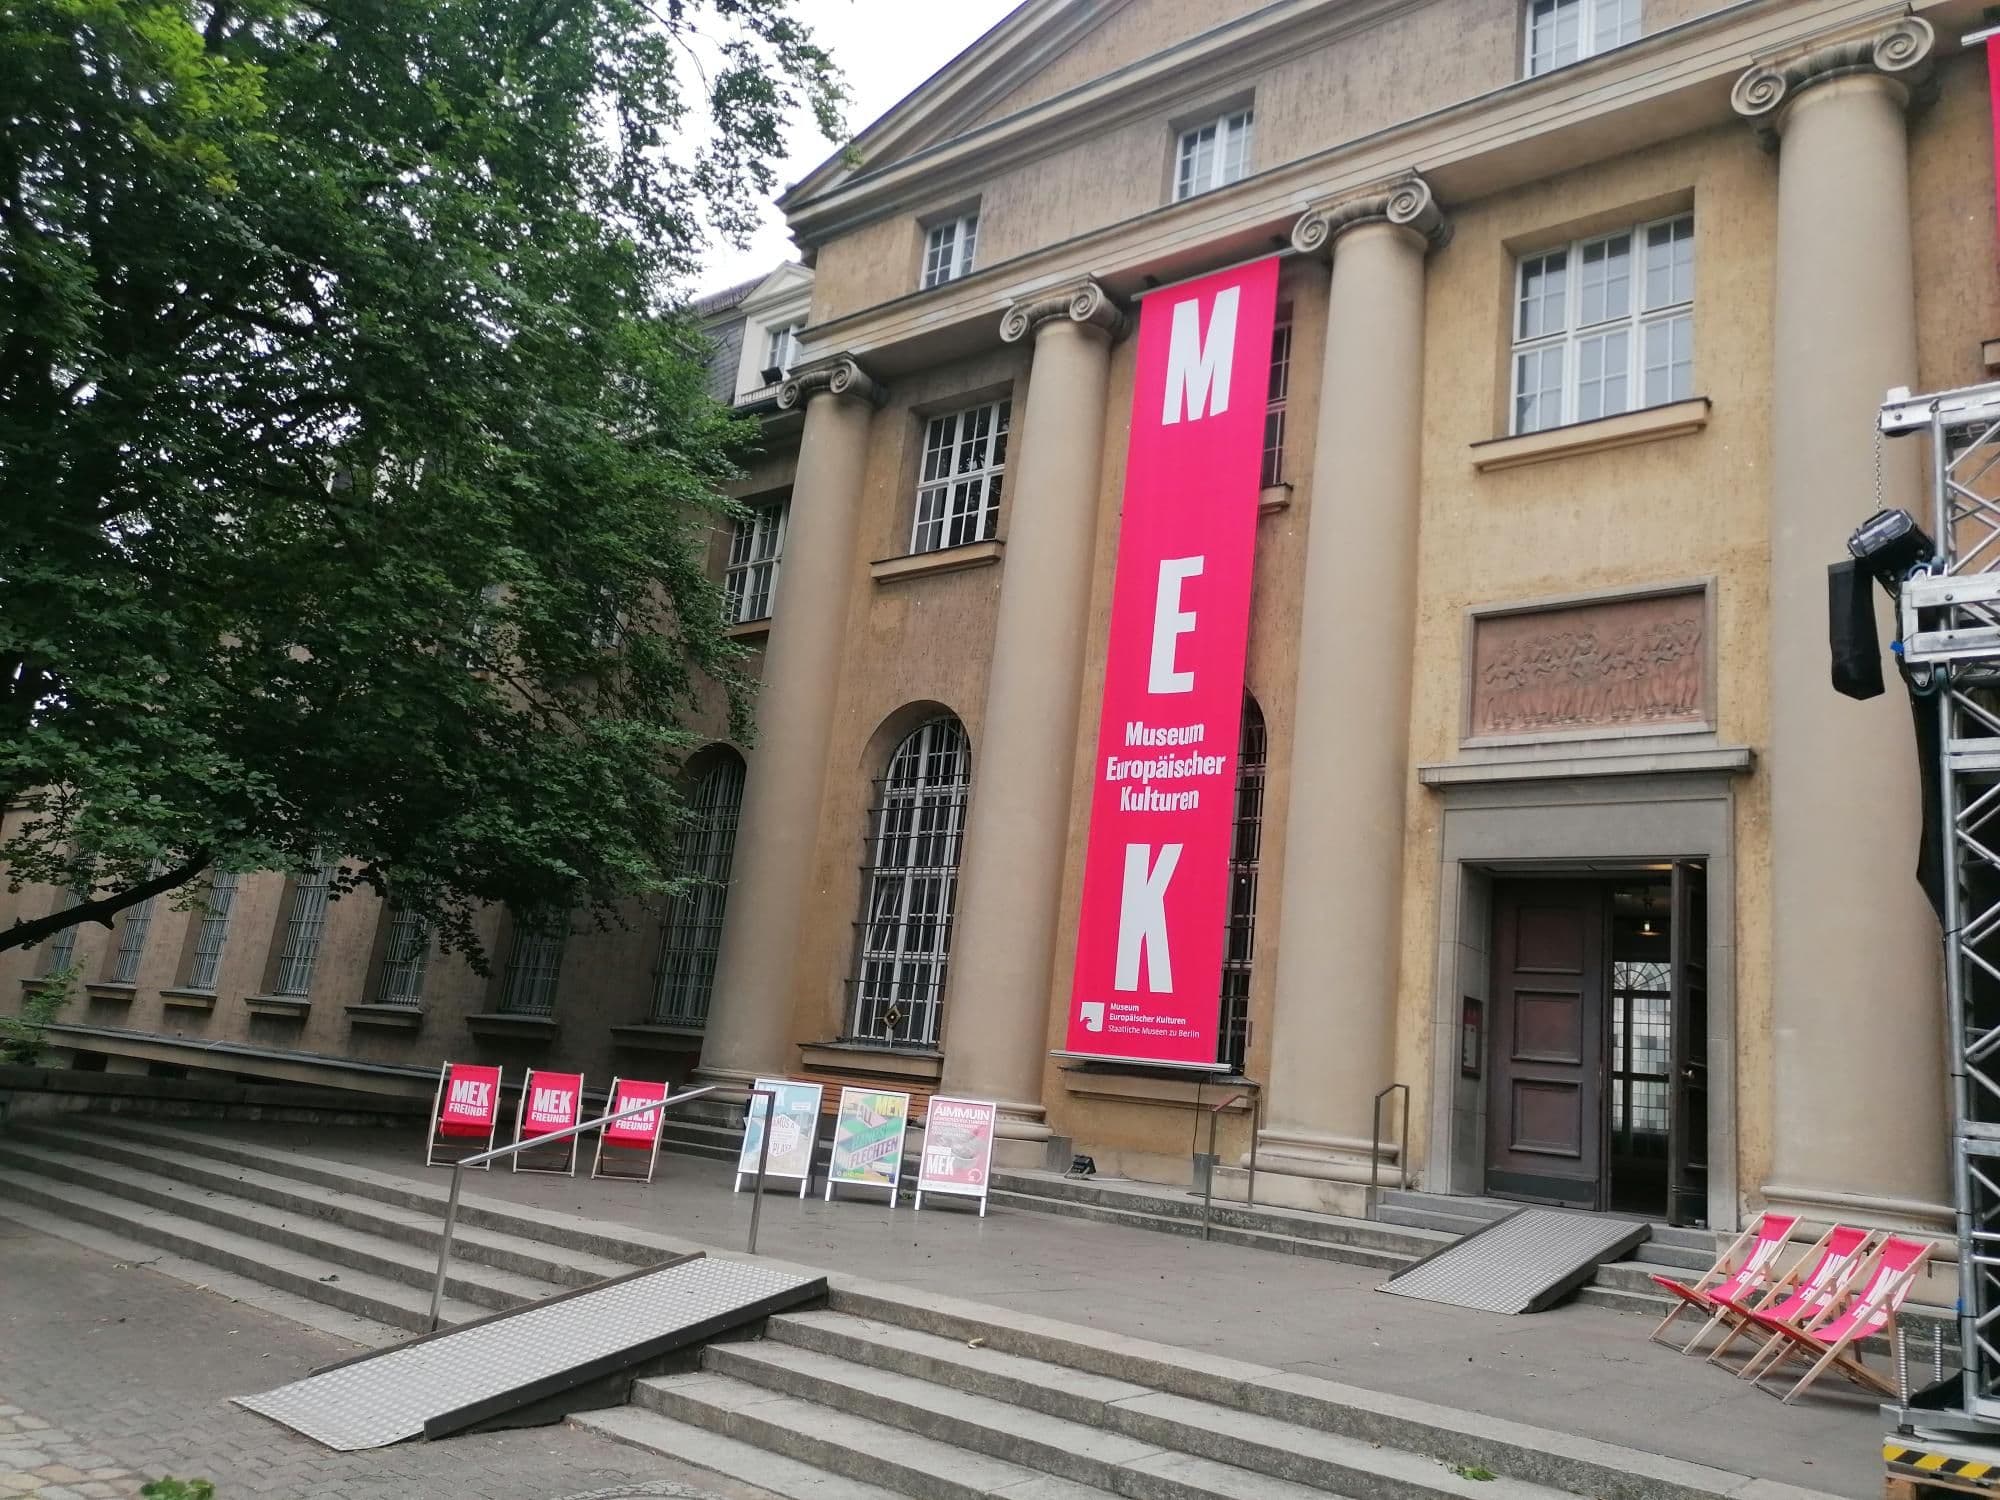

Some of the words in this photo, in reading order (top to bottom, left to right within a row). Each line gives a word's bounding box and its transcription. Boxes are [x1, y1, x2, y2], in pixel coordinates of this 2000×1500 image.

[1162, 285, 1240, 425] M
[1148, 555, 1204, 694] E
[1125, 721, 1205, 747] Museum
[1106, 750, 1226, 784] Europäischer
[1120, 786, 1199, 812] Kulturen
[1114, 843, 1184, 993] K
[1109, 1012, 1154, 1024] Europäischer
[1156, 1016, 1186, 1025] Kulturen
[1110, 1002, 1139, 1012] Museum
[1108, 1025, 1140, 1034] Staatliche
[1141, 1027, 1168, 1036] Museen
[1178, 1029, 1200, 1038] Berlin
[450, 1079, 492, 1106] MEK
[532, 1087, 574, 1114] MEK
[448, 1102, 489, 1117] FREUNDE
[531, 1113, 571, 1123] FREUNDE
[618, 1096, 658, 1122] MEK
[615, 1119, 653, 1131] FREUNDE
[848, 1136, 898, 1169] FLECHTEN
[926, 1154, 955, 1176] MEK
